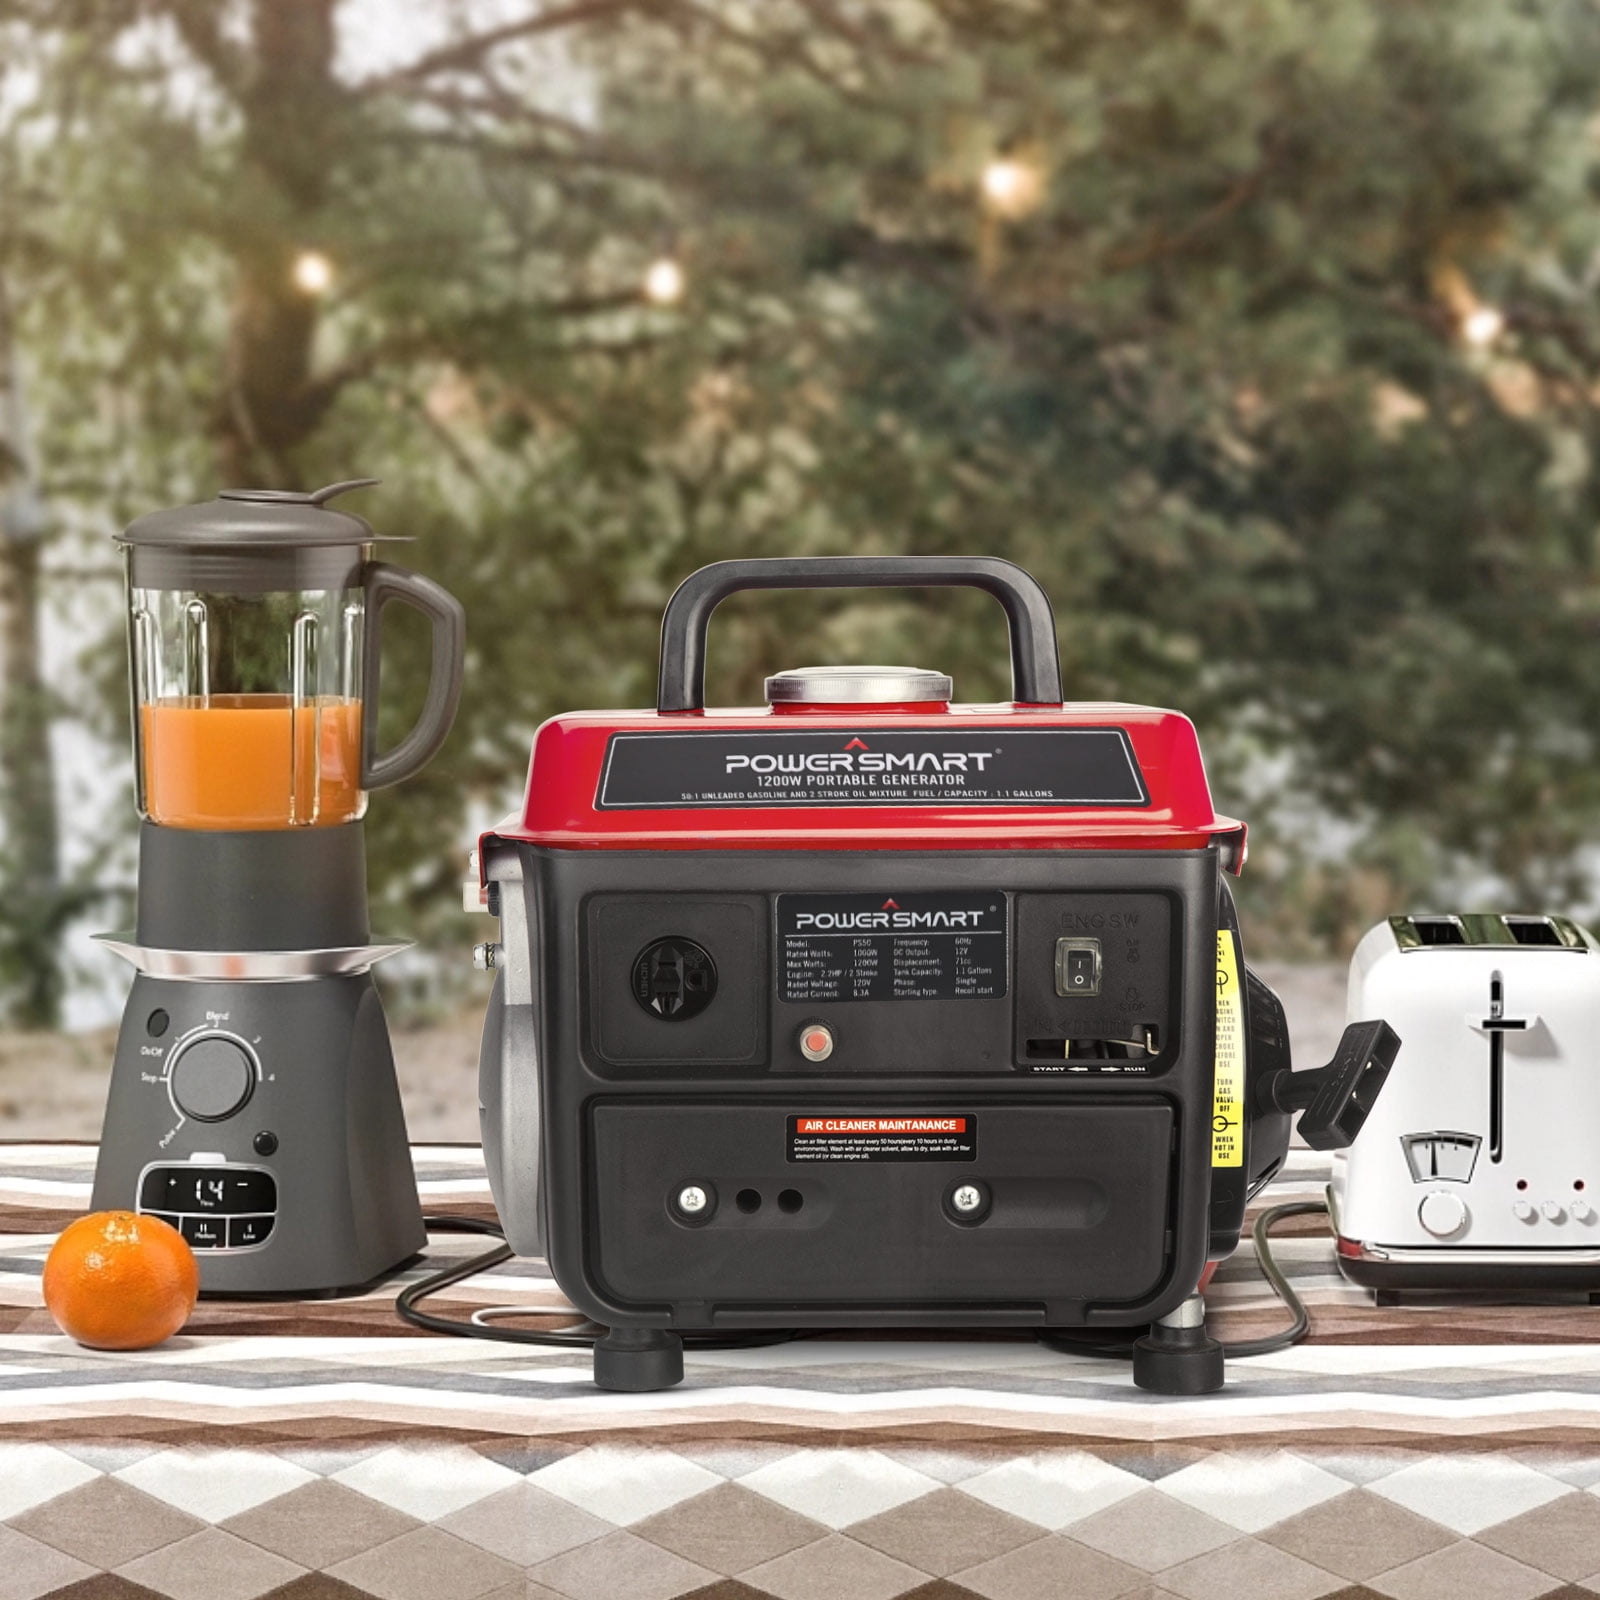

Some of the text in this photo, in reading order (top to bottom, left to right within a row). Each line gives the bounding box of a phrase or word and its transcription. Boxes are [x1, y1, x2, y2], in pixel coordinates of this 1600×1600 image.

[757, 773, 965, 787] 1200W PORTABLE GENERATOR
[701, 792, 745, 800] UNLEADED
[747, 791, 787, 799] GASOLINE
[809, 790, 815, 798] 2
[817, 790, 850, 798] STROKE
[944, 789, 988, 797] CAPACITY
[786, 949, 808, 958] Rated
[955, 947, 968, 955] 12V
[786, 960, 802, 968] Max
[854, 959, 878, 967] 1200W
[849, 969, 854, 977] 2
[893, 968, 910, 976] Tank
[967, 966, 992, 975] Gallons
[787, 980, 809, 988] Rated
[854, 979, 871, 987] 120V
[955, 977, 977, 985] Single
[787, 990, 809, 998] Rated
[804, 1120, 957, 1130] AIR CLEANER MAINTANANCE
[195, 1179, 224, 1201] 14
